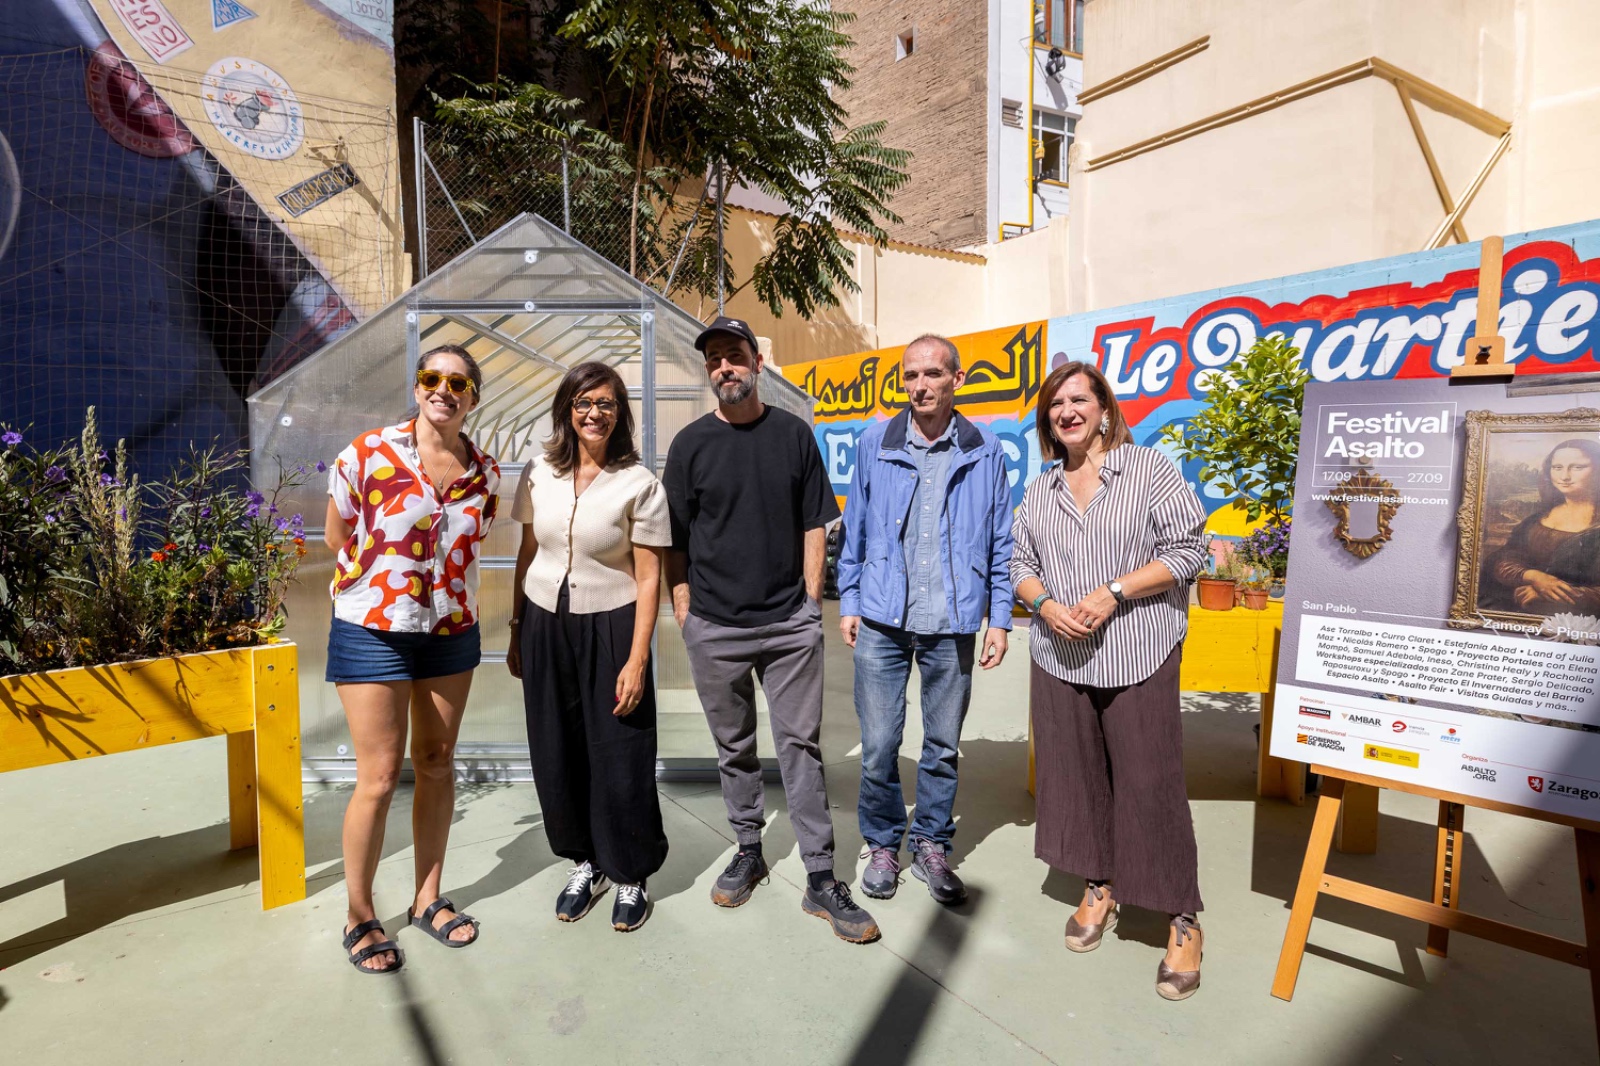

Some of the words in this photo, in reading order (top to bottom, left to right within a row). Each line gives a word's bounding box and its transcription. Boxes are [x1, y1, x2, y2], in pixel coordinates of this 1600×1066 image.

[355, 1, 384, 18] SOTO
[143, 25, 178, 52] NO
[1103, 334, 1177, 395] Le
[1327, 410, 1449, 434] Festival
[1324, 436, 1425, 458] Asalto
[1322, 471, 1352, 482] 17.09
[1407, 473, 1443, 483] 27.09
[1311, 492, 1449, 505] www.festivalasalto.com
[1302, 600, 1323, 611] San
[1325, 602, 1357, 614] Pablo
[1483, 619, 1543, 636] Zamoray
[1317, 633, 1334, 641] Maz
[1343, 636, 1374, 647] Nicolás
[1376, 640, 1409, 651] Romero
[1418, 645, 1447, 656] Spogo
[1457, 650, 1500, 662] Proyecto
[1502, 656, 1544, 668] Portales
[1546, 662, 1565, 670] con
[1568, 663, 1598, 674] Elena
[1320, 625, 1336, 633] Ase
[1338, 627, 1373, 637] Torralba
[1381, 632, 1406, 641] Curro
[1408, 635, 1435, 645] Claret
[1444, 639, 1488, 651] Estefanía
[1490, 644, 1517, 654] Abad
[1527, 649, 1553, 659] Land
[1555, 653, 1567, 661] of
[1569, 654, 1595, 664] Julia
[1316, 651, 1362, 662] Workshops
[1364, 657, 1429, 671] especializados
[1431, 666, 1448, 675] con
[1451, 668, 1475, 678] Zane
[1477, 672, 1508, 684] Prater,
[1511, 675, 1544, 688] Sergio
[1546, 680, 1595, 695] Delicado,
[1353, 646, 1385, 657] Samuel
[1386, 650, 1424, 662] Adebola,
[1427, 656, 1454, 666] Ineso,
[1457, 659, 1500, 672] Christina
[1502, 665, 1532, 677] Healy
[1534, 671, 1541, 679] y
[1542, 671, 1595, 684] Rocholica
[1322, 660, 1372, 673] Raposuroxu
[1380, 668, 1409, 679] Spogo
[1418, 673, 1459, 685] Proyecto
[1461, 679, 1470, 687] El
[1472, 681, 1532, 695] Invernadero
[1533, 690, 1550, 698] del
[1552, 693, 1585, 703] Barrio
[1327, 669, 1360, 680] Espacio
[1361, 675, 1389, 685] Asalto
[1398, 680, 1427, 690] Asalto
[1429, 684, 1447, 693] Fair
[1457, 688, 1490, 699] Visitas
[1491, 693, 1534, 706] Guiadas
[1536, 700, 1543, 709] y
[1297, 723, 1315, 732] Apoyo
[1348, 714, 1382, 727] AMBAR
[1308, 735, 1341, 745] GOBIERNO
[1460, 764, 1497, 776] ASALTO
[1548, 780, 1600, 801] Zarago
